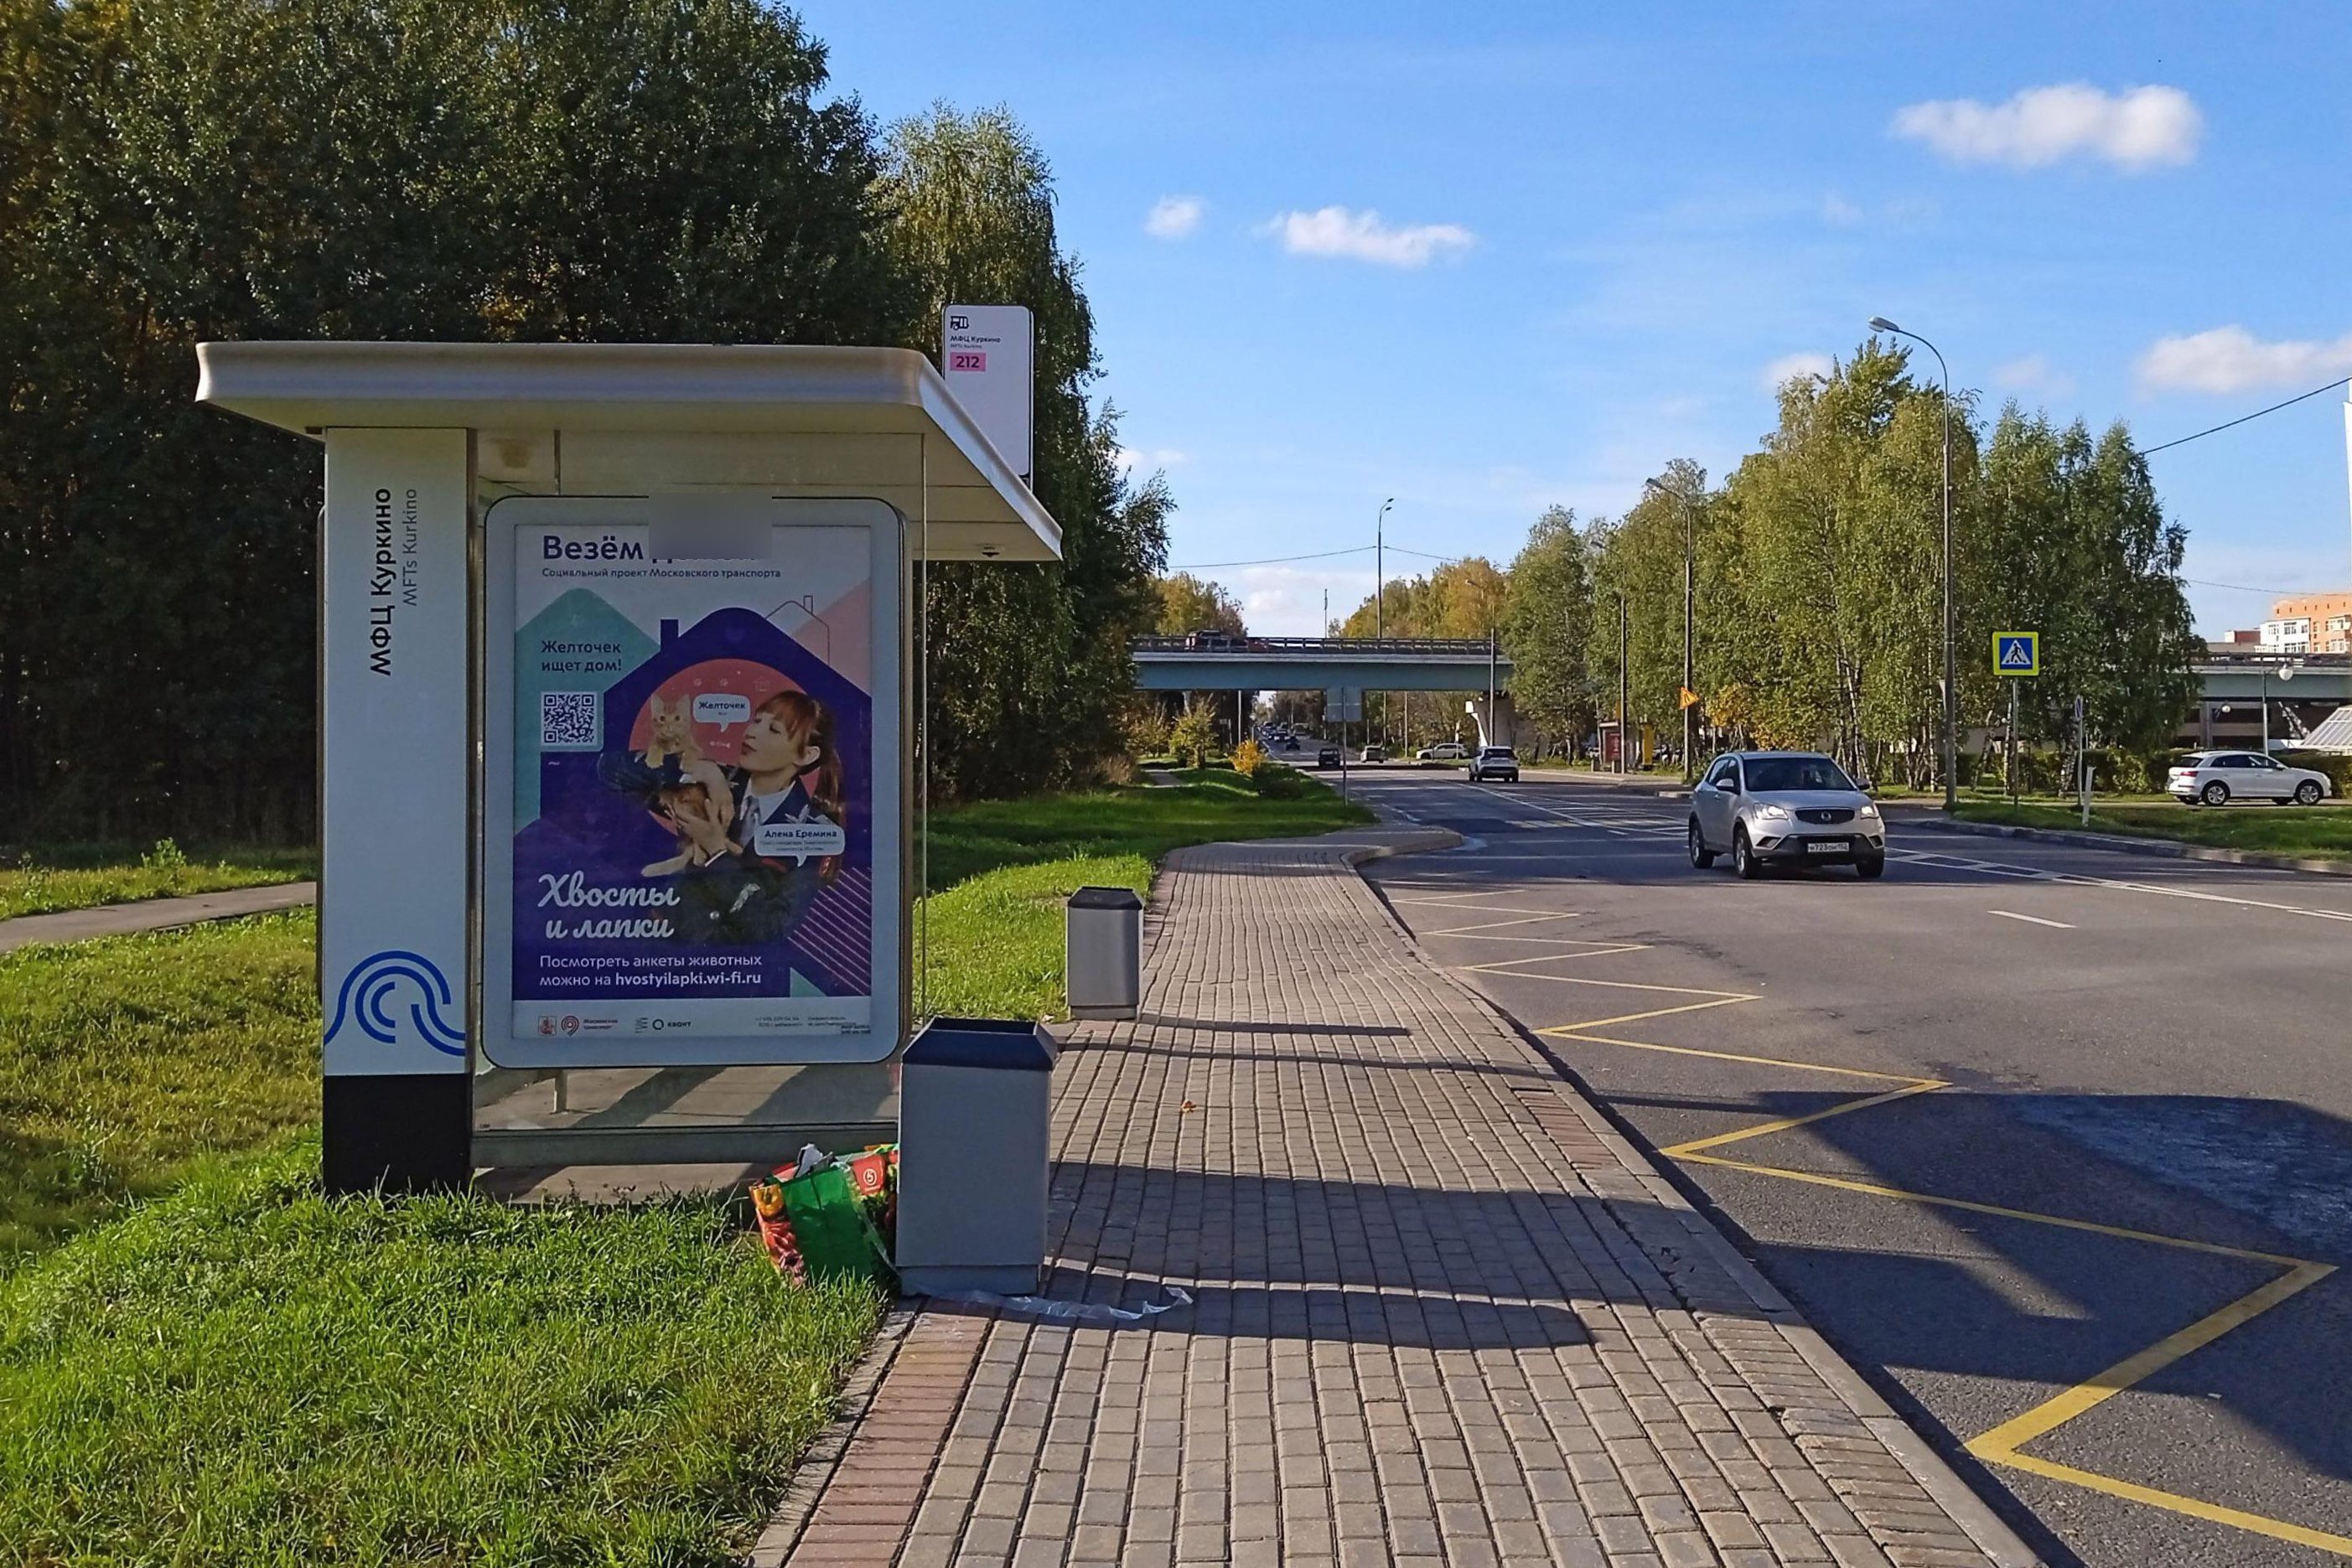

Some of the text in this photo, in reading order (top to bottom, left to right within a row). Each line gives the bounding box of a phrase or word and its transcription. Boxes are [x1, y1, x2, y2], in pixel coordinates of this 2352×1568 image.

[971, 335, 1001, 344] Куркино
[956, 355, 980, 369] 212
[402, 489, 417, 606] MFTs Kurkino
[543, 535, 644, 560] Везём
[541, 567, 781, 579] Социальный проект Московского транспорта
[370, 489, 396, 676] МФЦ Куркино
[541, 640, 621, 653] Желточек
[541, 659, 622, 673] ищет дом!
[698, 701, 746, 710] Желточек
[764, 830, 837, 839] Алена Еремина
[537, 870, 681, 907] Хвосты
[546, 917, 675, 939] и лапки
[540, 955, 762, 970] Посмотреть анкеты животных
[539, 972, 761, 988] можно на hvostyilapki.wi-fi.ru
